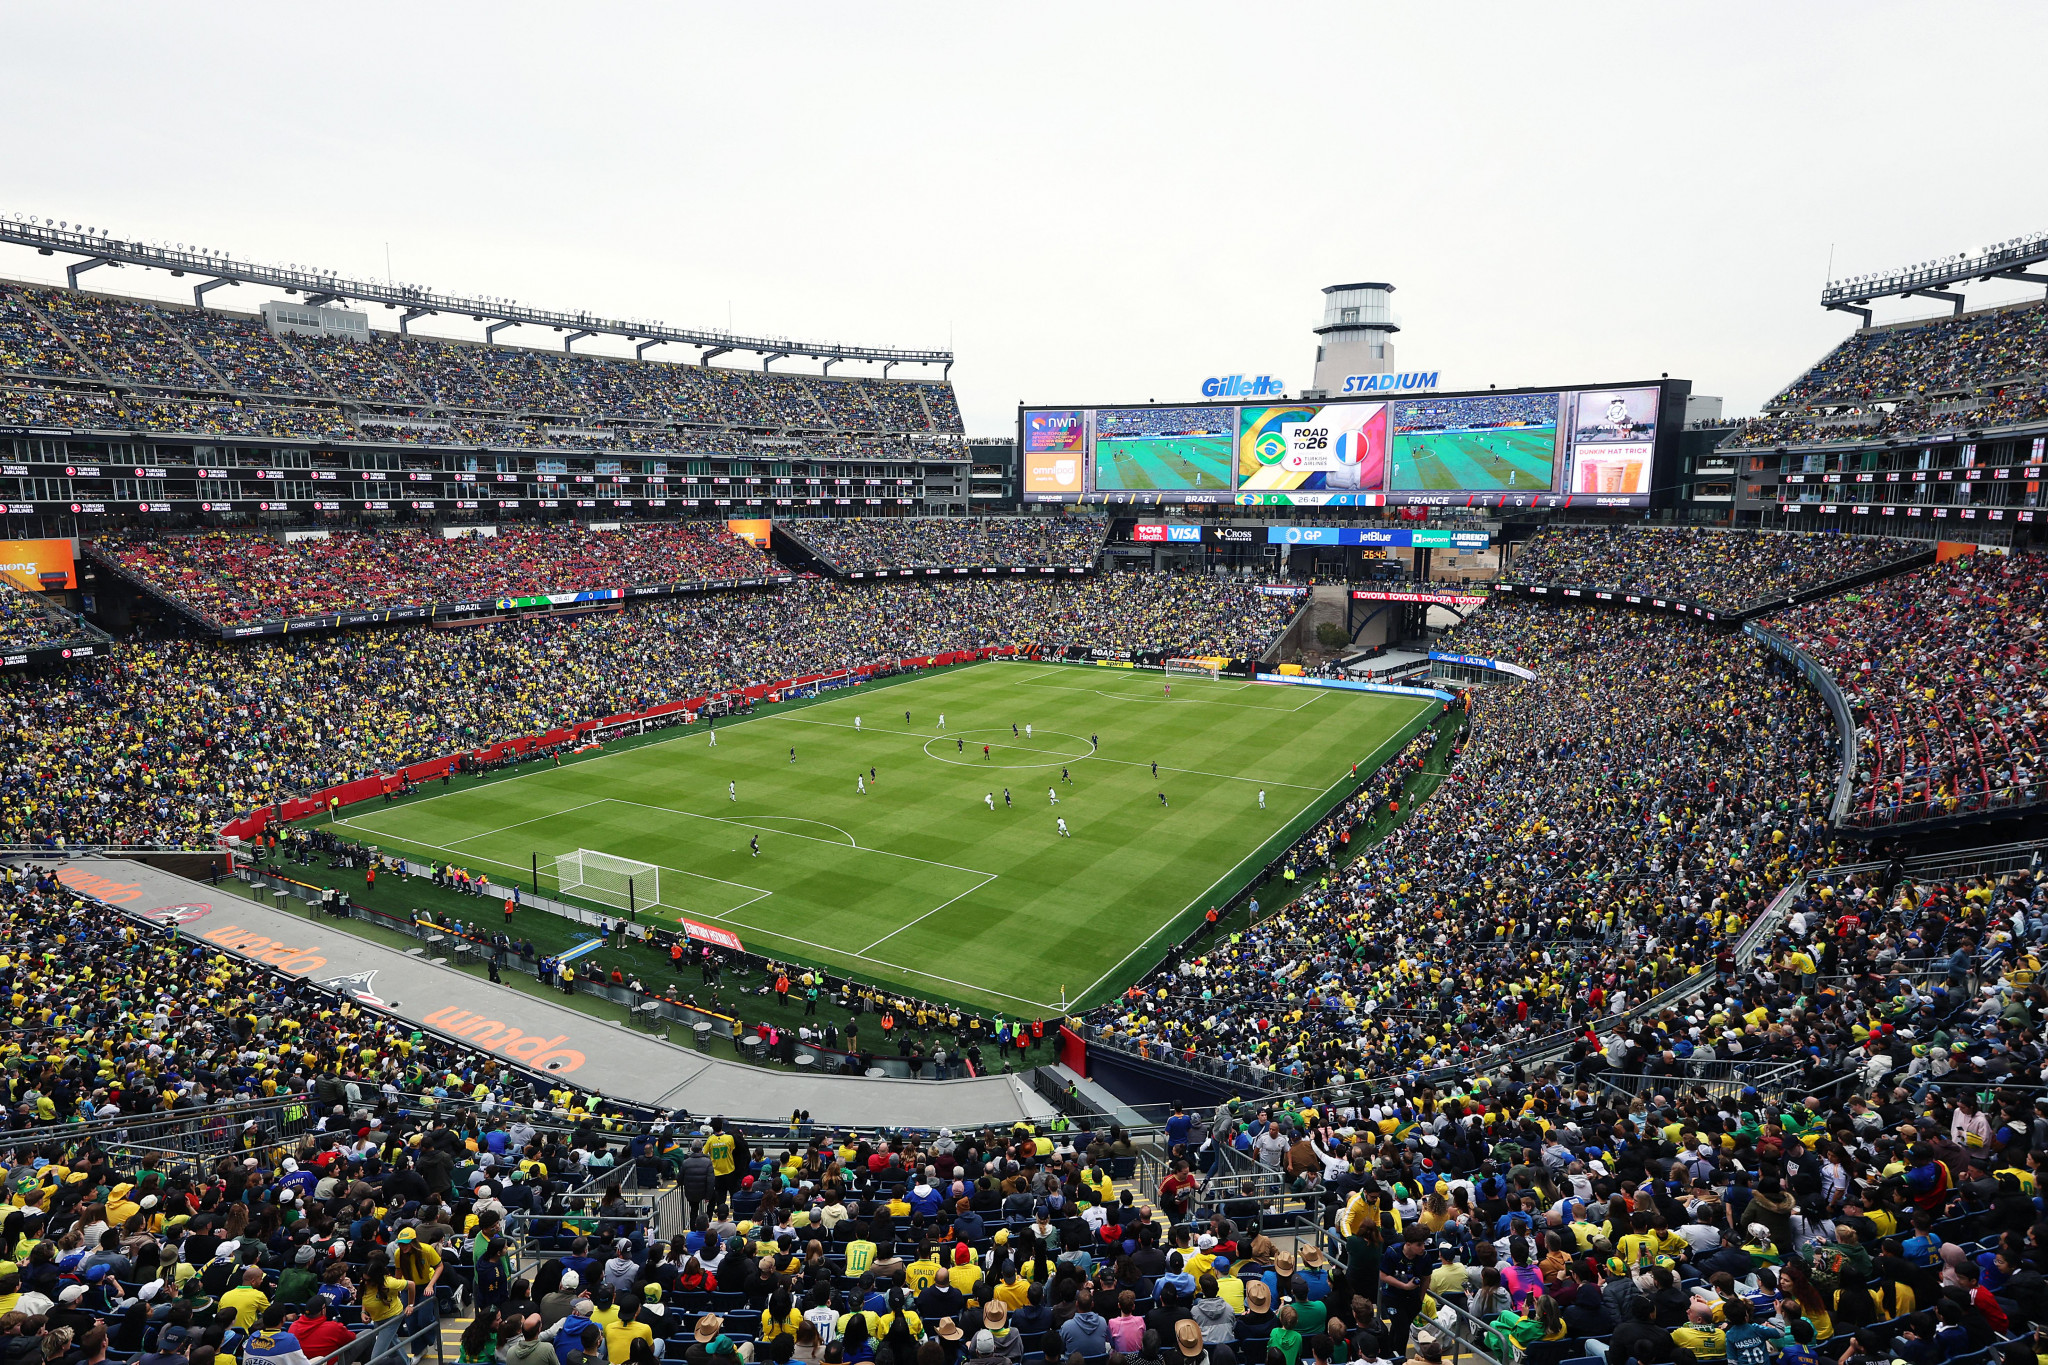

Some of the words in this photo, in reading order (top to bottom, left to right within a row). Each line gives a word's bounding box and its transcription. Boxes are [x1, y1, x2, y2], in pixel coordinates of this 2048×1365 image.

[1202, 375, 1283, 397] Gillette
[1343, 372, 1438, 392] STADIUM
[1048, 418, 1076, 427] nwn
[1294, 428, 1328, 437] ROAD
[1306, 437, 1328, 449] 26
[1408, 496, 1449, 505] FRANCE
[1169, 528, 1199, 540] VISA
[1304, 531, 1321, 540] GP
[1359, 532, 1392, 543] jetBlue
[1363, 550, 1386, 559] 26:42
[455, 604, 481, 612] BRAZIL
[1091, 649, 1114, 657] ROAD
[1465, 657, 1488, 666] ULTRA
[712, 1146, 728, 1160] 87
[851, 1250, 867, 1271] 10
[1734, 1336, 1762, 1349] HASSAN
[1742, 1347, 1764, 1364] 10
